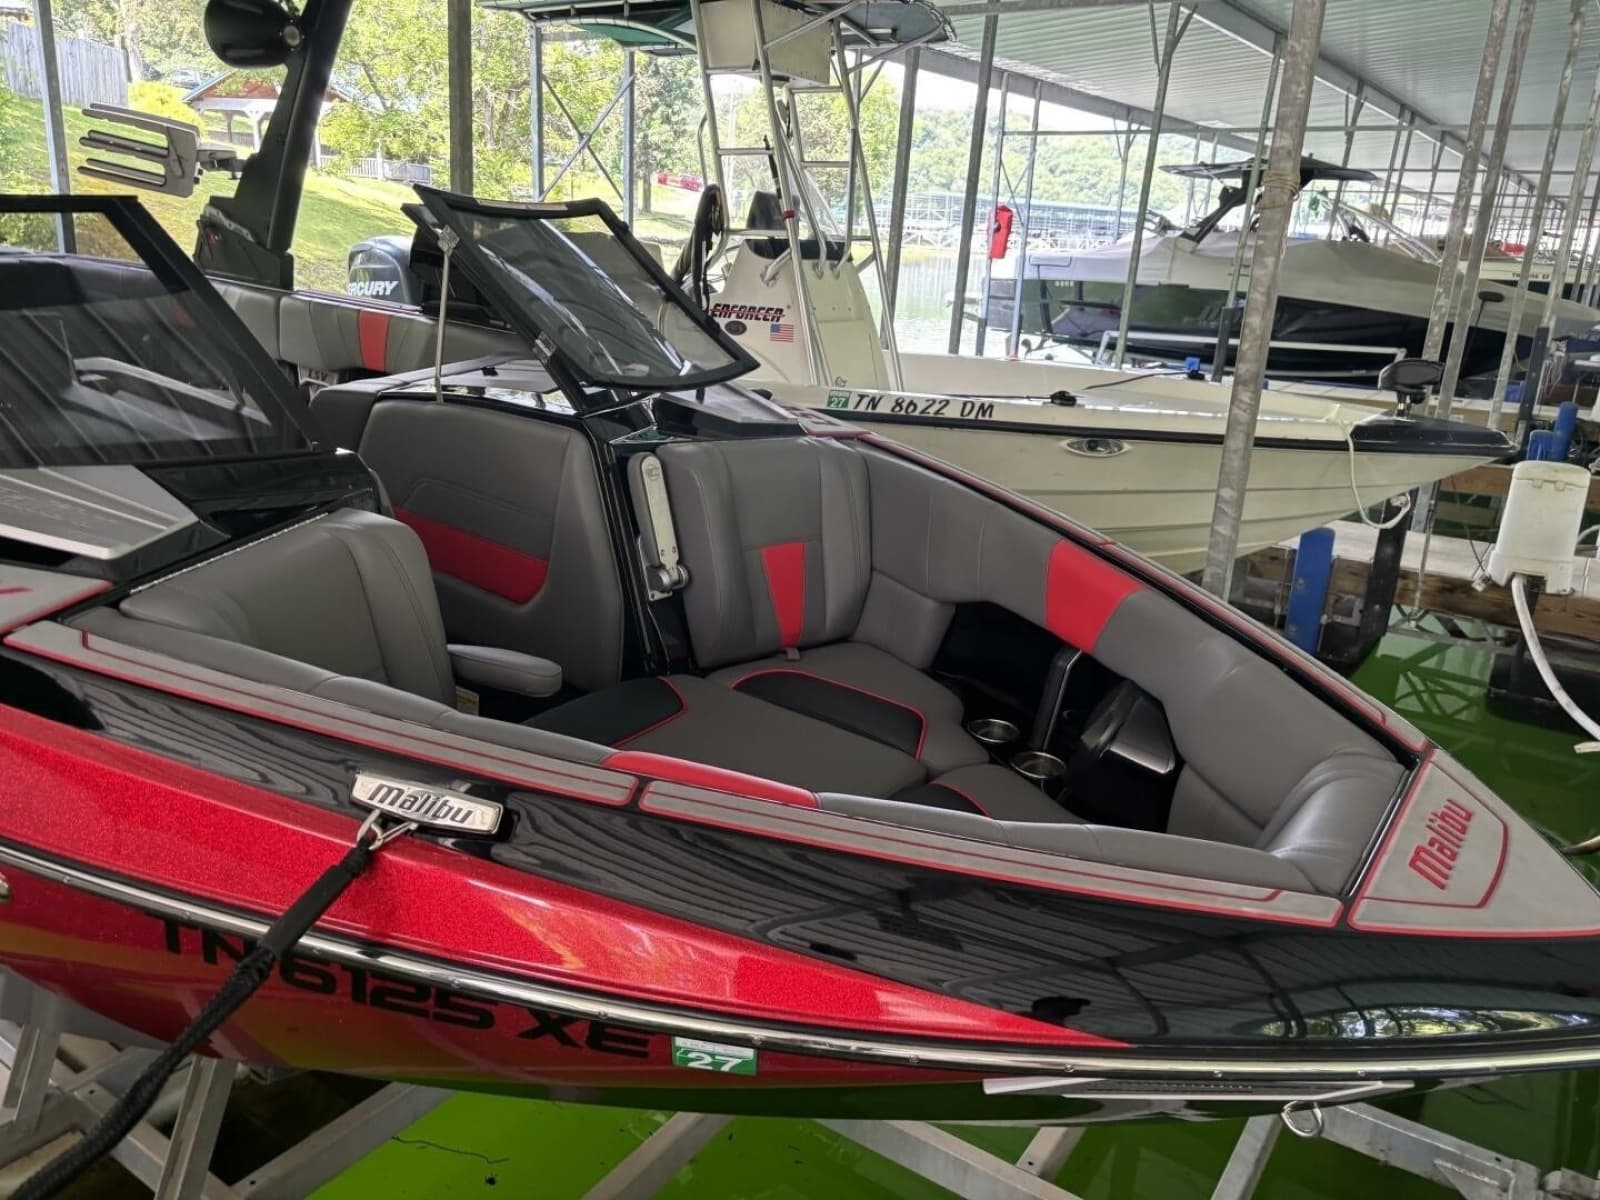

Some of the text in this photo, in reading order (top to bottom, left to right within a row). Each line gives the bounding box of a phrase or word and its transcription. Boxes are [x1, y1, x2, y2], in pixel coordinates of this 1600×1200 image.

[830, 397, 846, 408] 27
[853, 394, 994, 419] TN 8622 DM
[1408, 798, 1473, 890] Malibu
[280, 954, 497, 1029] 6125
[517, 1008, 656, 1059] XE
[687, 1052, 742, 1073] 27
